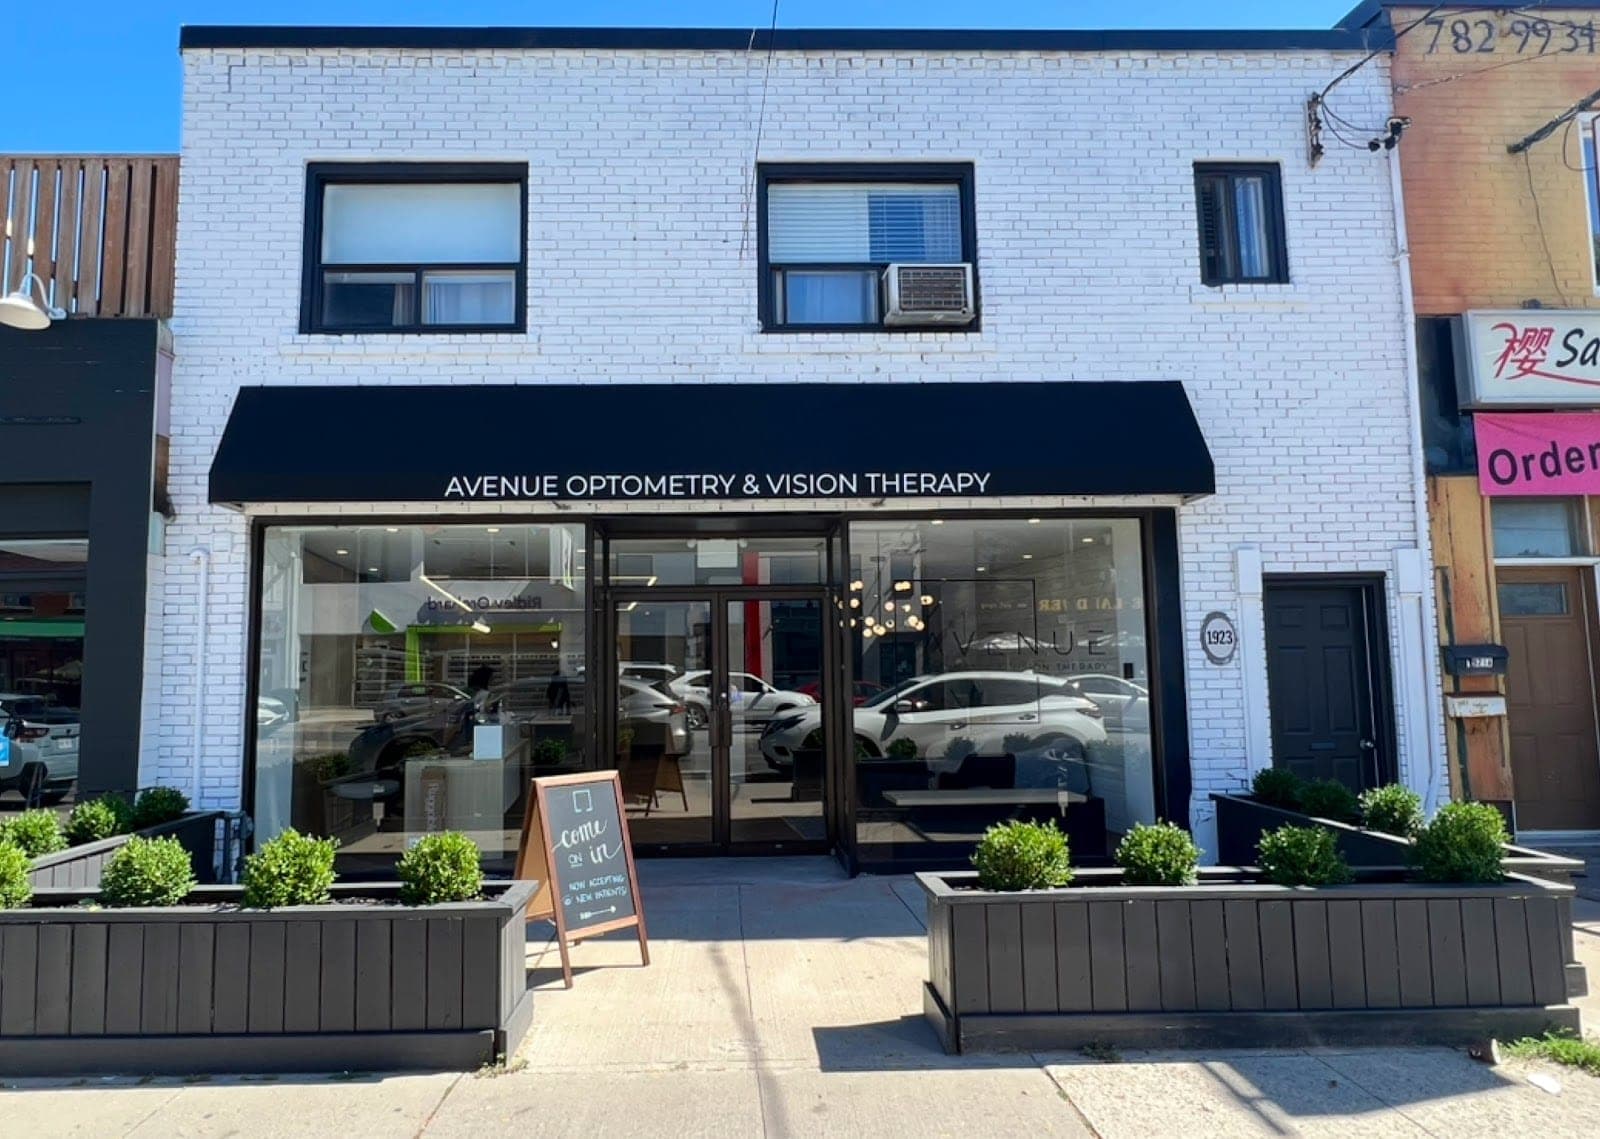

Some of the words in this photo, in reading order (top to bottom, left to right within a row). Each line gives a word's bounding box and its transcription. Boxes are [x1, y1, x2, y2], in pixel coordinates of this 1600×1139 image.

[1424, 17, 1495, 54] 782
[1488, 441, 1600, 485] Order
[444, 475, 558, 497] AVENUE
[565, 474, 735, 496] OPTOMETRY
[743, 474, 760, 495] &
[766, 473, 858, 495] VISION
[864, 472, 991, 494] THERAPY
[1207, 629, 1233, 645] 1923
